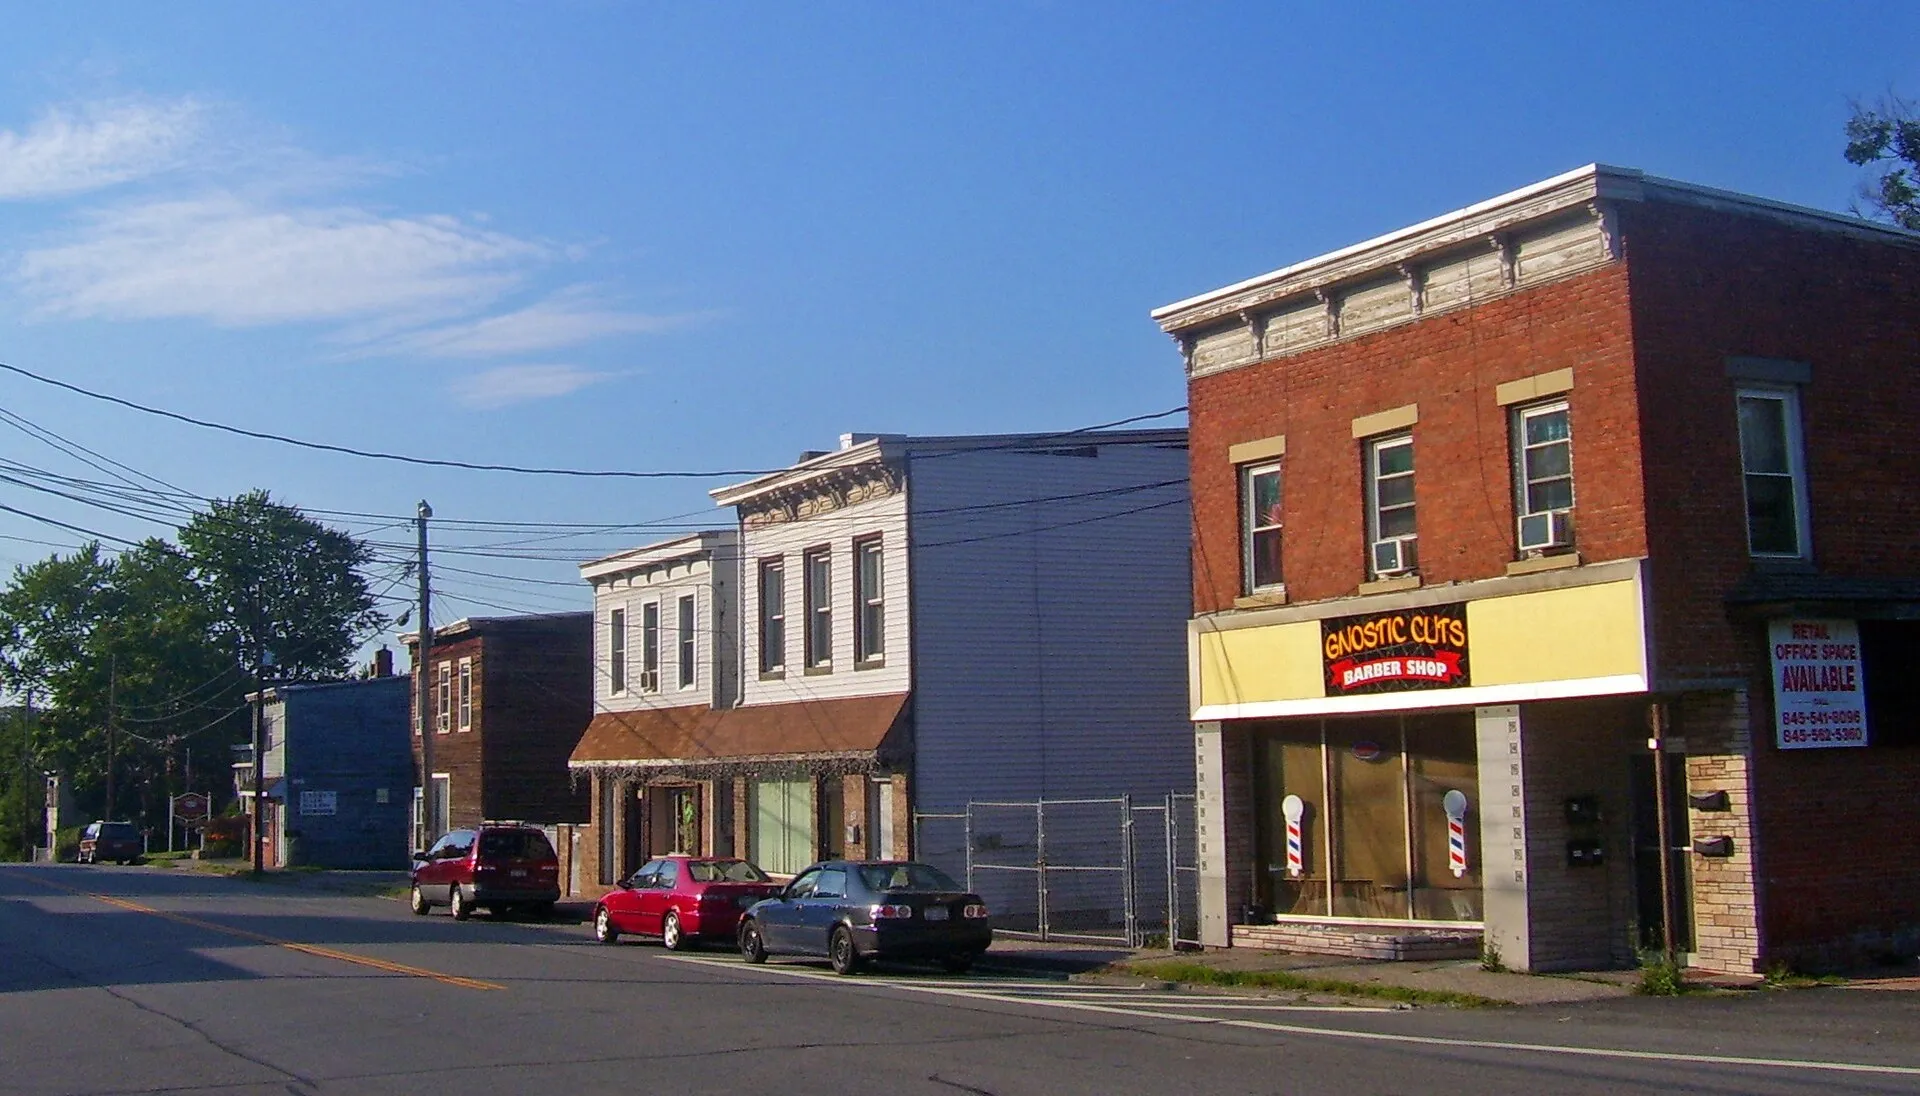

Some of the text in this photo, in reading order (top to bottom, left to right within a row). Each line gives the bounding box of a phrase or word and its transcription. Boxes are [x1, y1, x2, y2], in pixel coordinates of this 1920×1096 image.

[1325, 615, 1465, 659] GNOSTIC CUTS
[1792, 623, 1830, 640] RETAIL
[1776, 643, 1857, 660] OFFICE SPACE
[1343, 660, 1447, 686] BARBER SHOP
[1782, 665, 1856, 692] AVAILABLE
